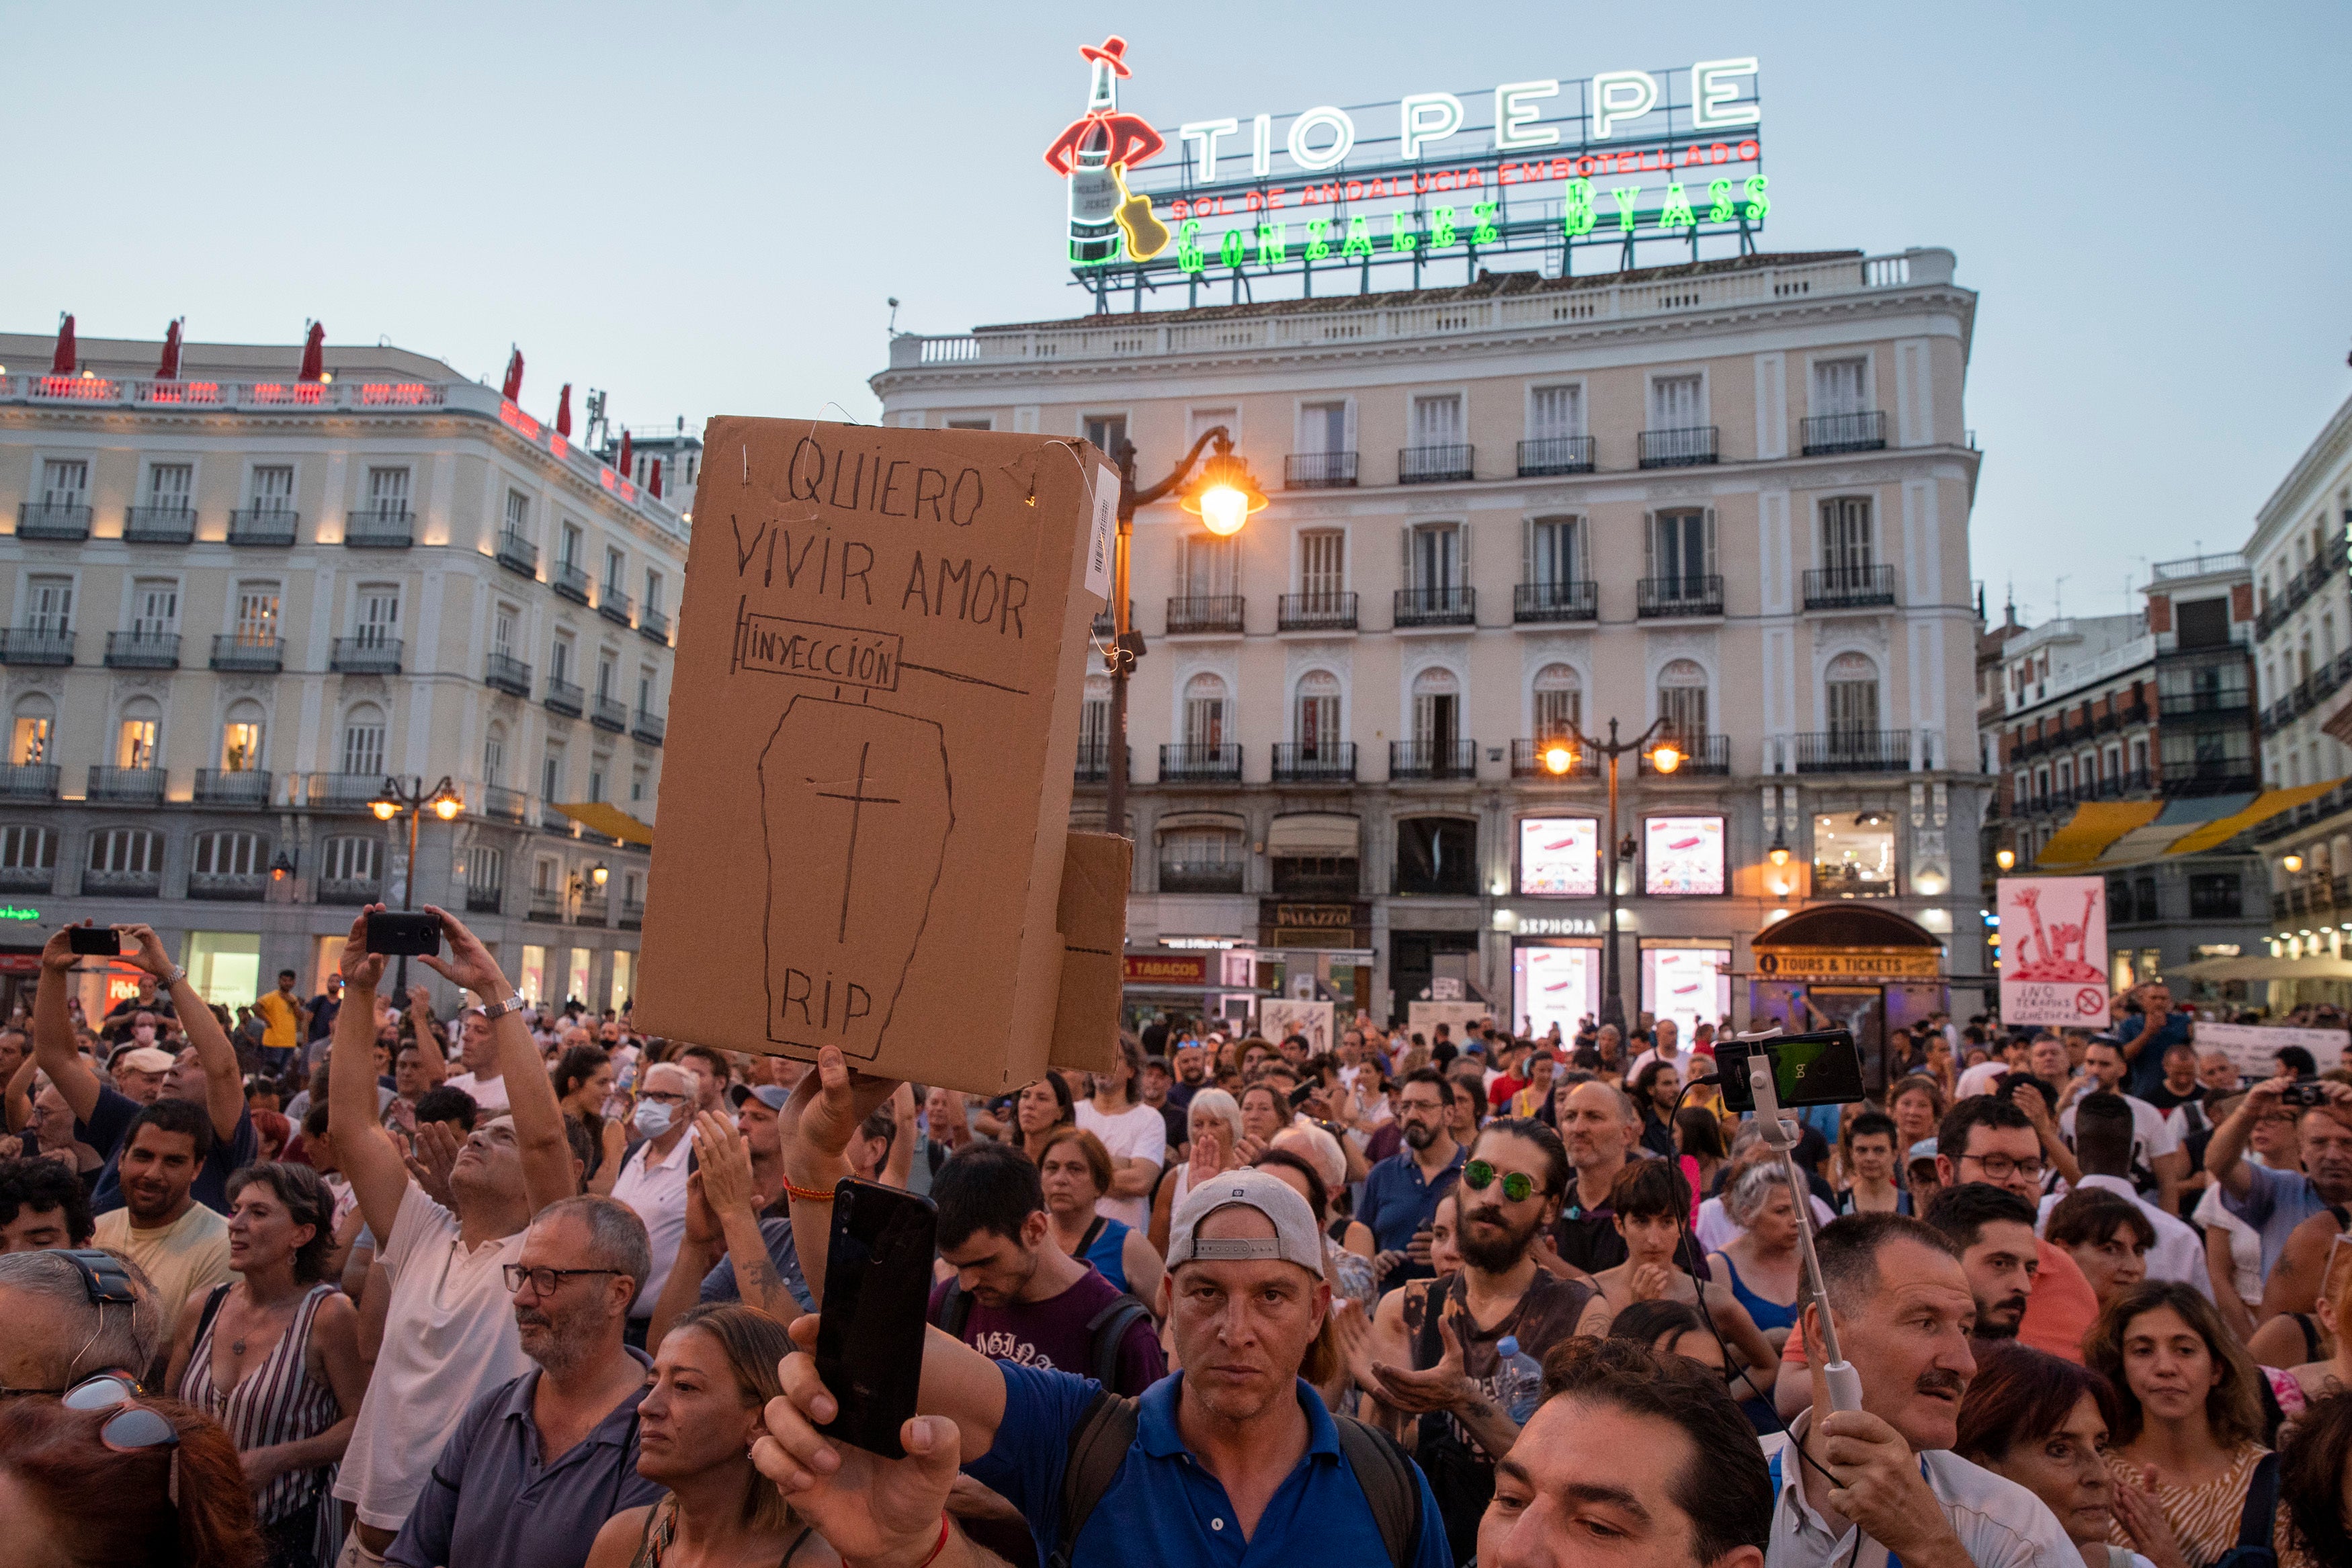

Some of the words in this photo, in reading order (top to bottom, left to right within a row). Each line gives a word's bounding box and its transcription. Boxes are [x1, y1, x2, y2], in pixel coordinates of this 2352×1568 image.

[1179, 105, 1355, 183] TIO
[1401, 56, 1760, 160] PEPE
[1172, 198, 1234, 220] SOL
[1247, 189, 1286, 212] DE
[1300, 167, 1483, 206] ANDALUCIA
[1499, 140, 1760, 186] EMBOTELLADO
[902, 550, 1029, 639] AMOR
[1519, 918, 1597, 934] SEPHORA
[1136, 961, 1200, 976] TABACOS
[1783, 958, 1824, 971] TOURS
[1829, 958, 1839, 971] &
[1845, 958, 1902, 972] TICKETS
